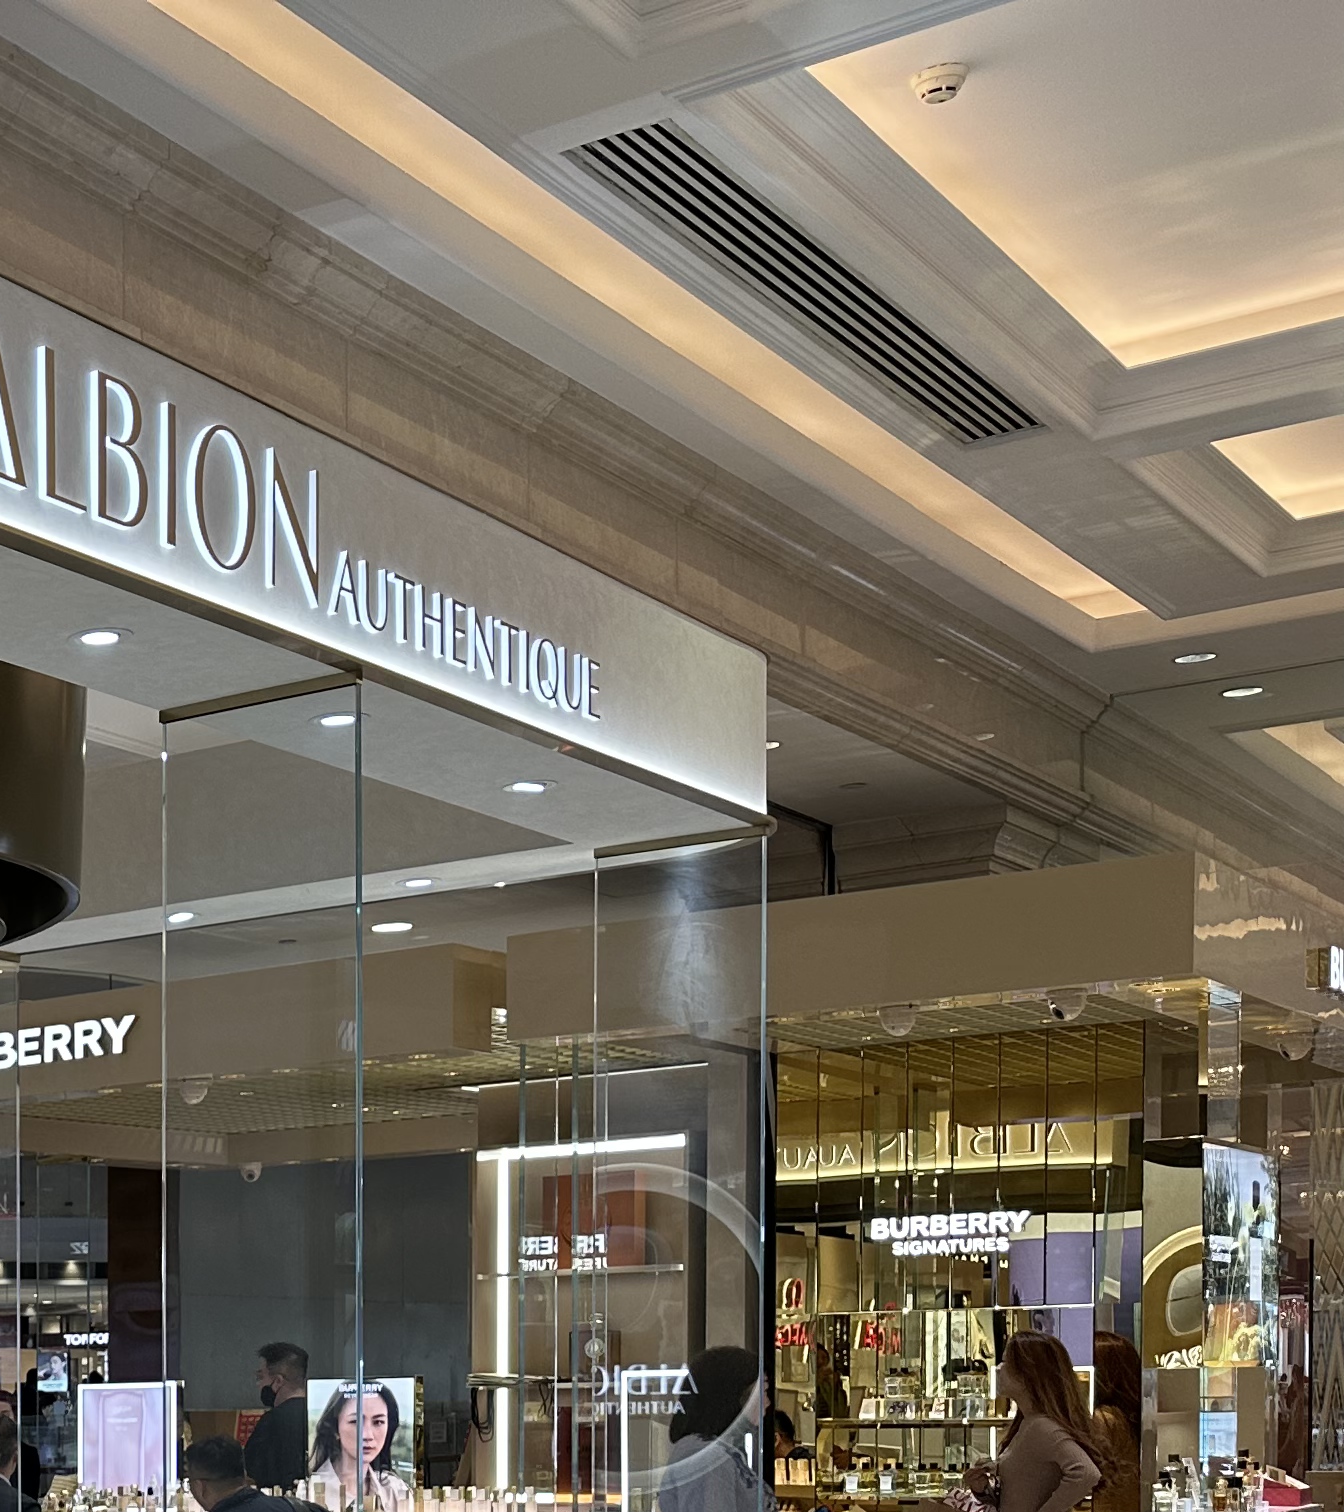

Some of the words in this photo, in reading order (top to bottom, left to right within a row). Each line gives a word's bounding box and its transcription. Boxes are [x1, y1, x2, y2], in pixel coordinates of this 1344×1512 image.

[327, 550, 601, 721] AUTHENTIQUE
[870, 1210, 1032, 1241] BURBERRY
[891, 1236, 1010, 1256] SIGNATURES
